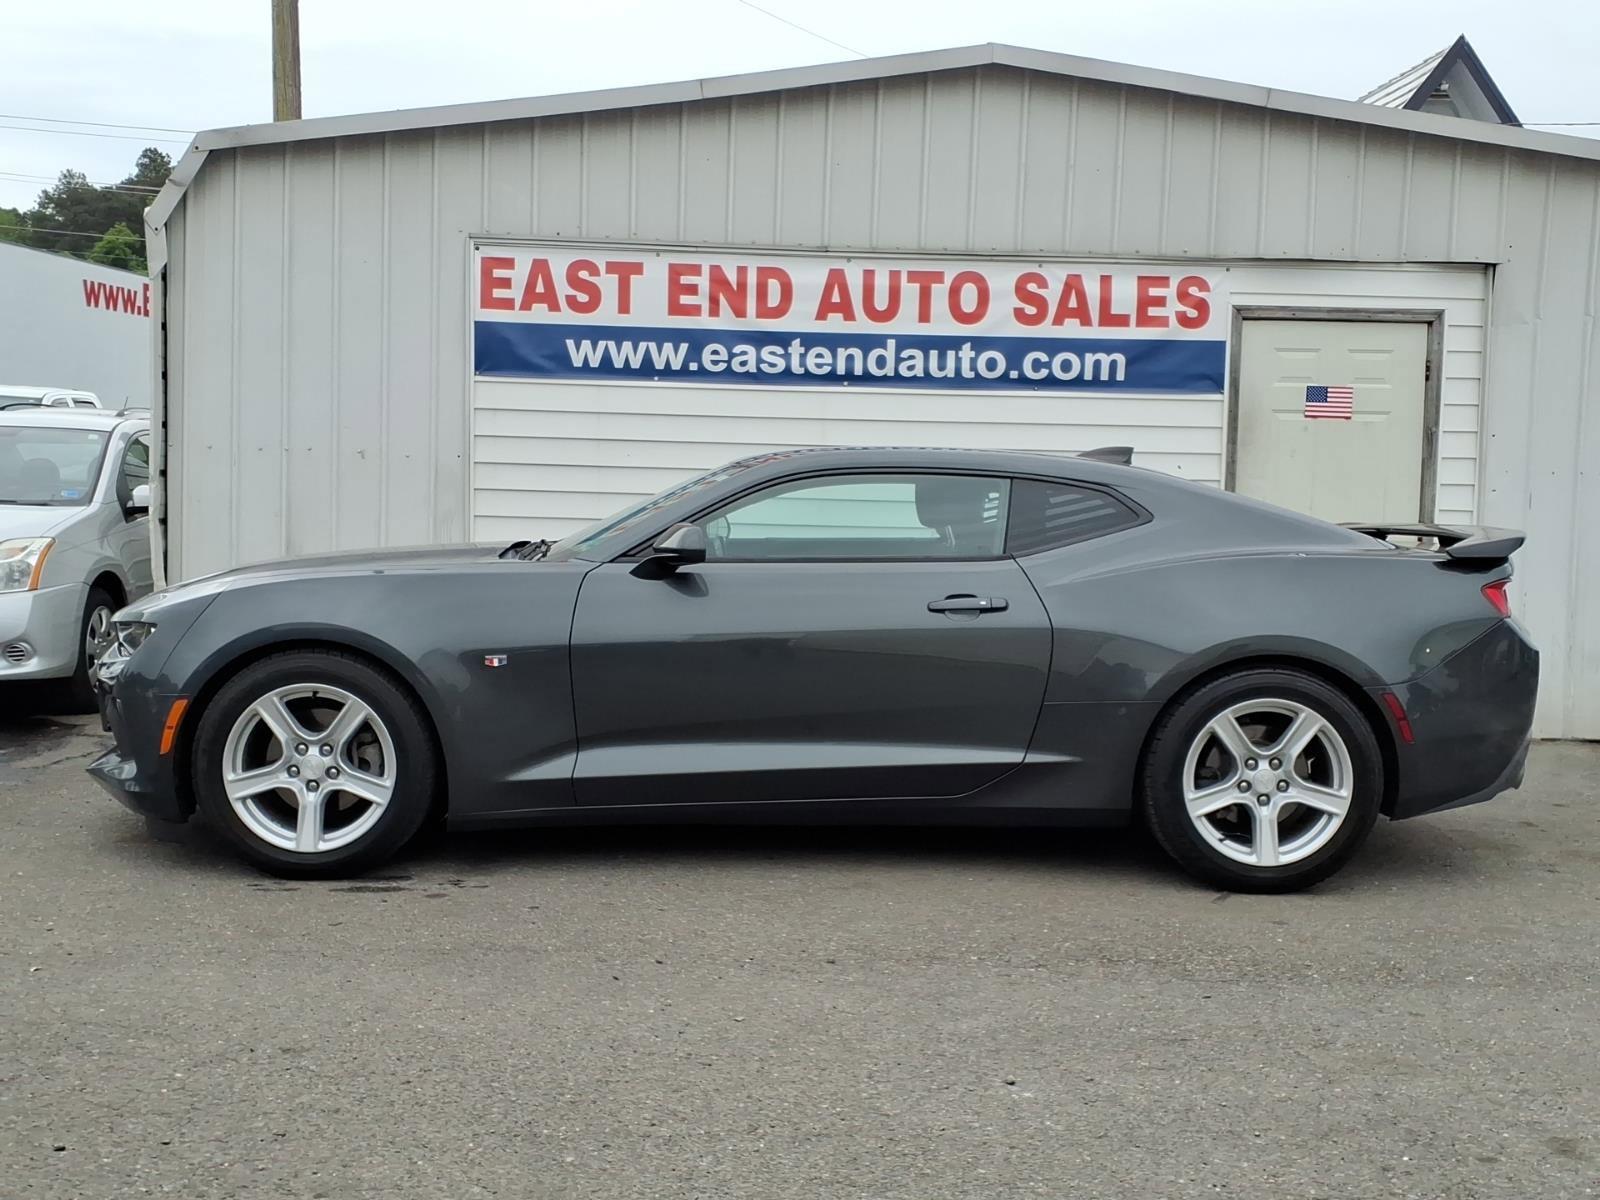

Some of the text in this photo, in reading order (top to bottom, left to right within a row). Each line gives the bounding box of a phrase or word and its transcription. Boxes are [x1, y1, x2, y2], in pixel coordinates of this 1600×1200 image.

[479, 256, 1211, 331] EAST END AUTO SALES
[565, 337, 1127, 382] www.eastendauto.com
